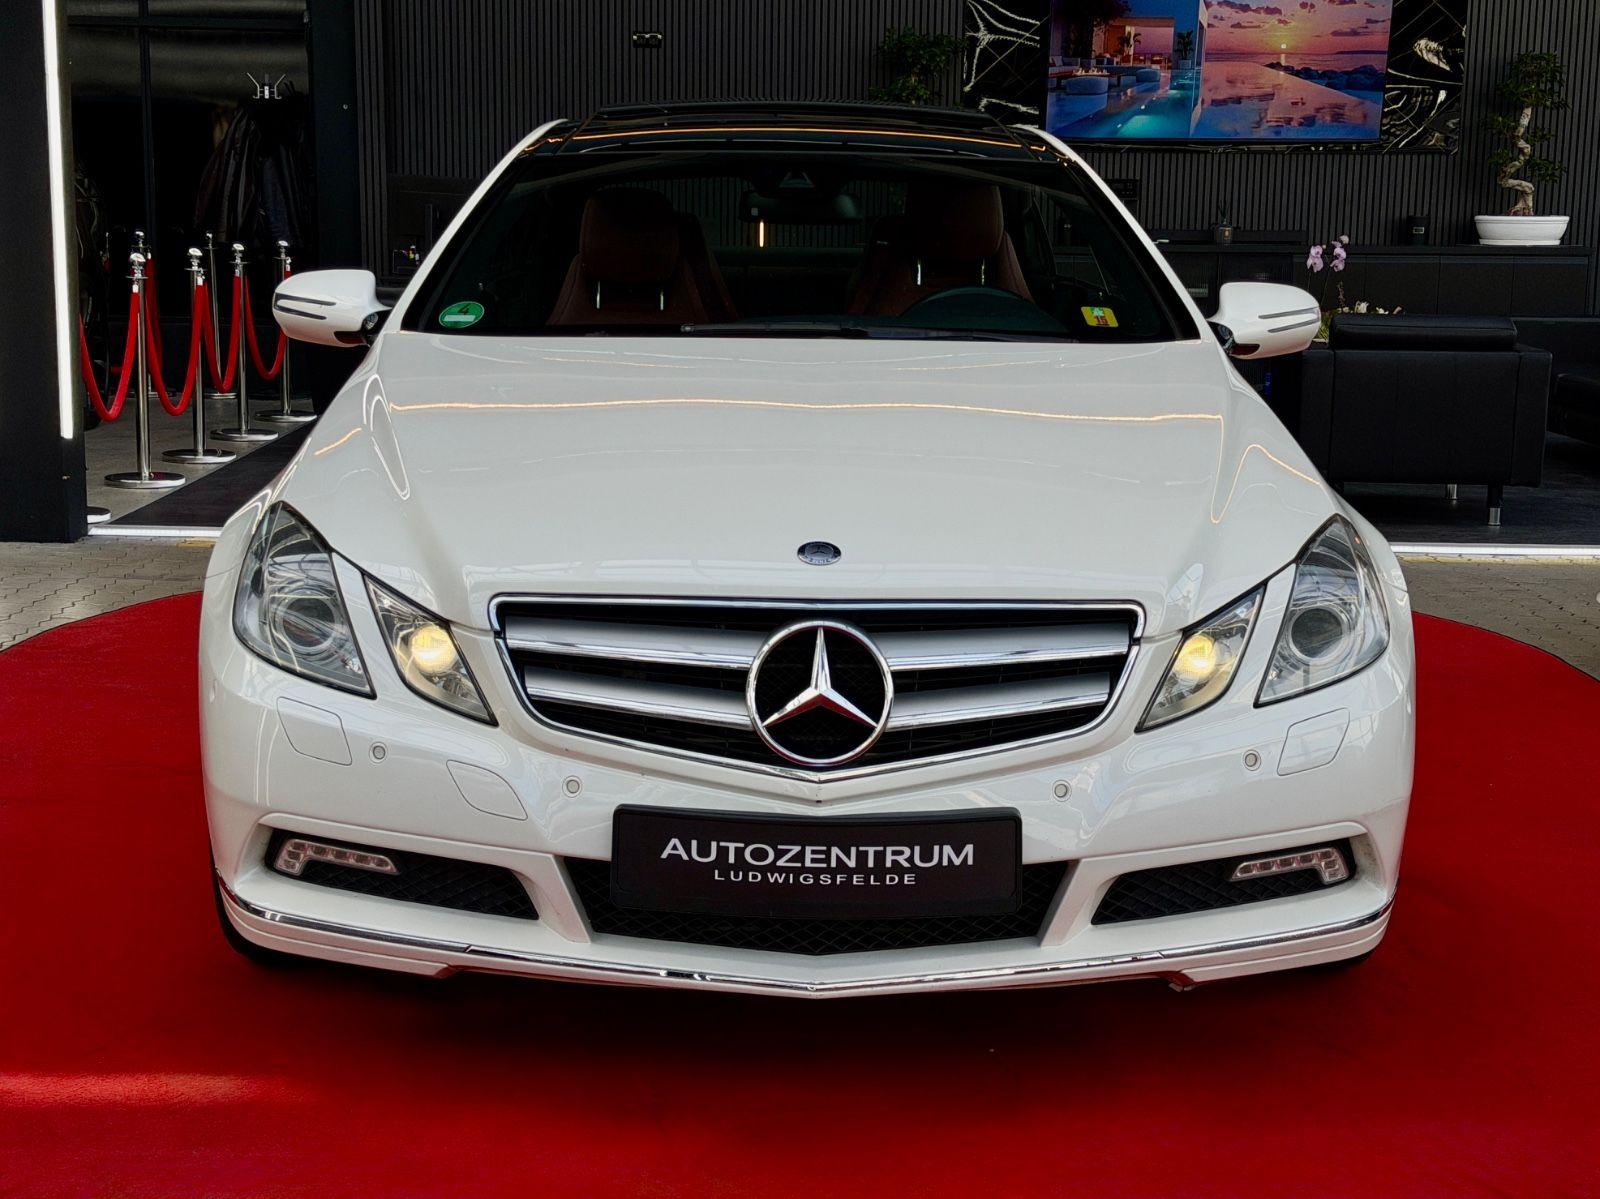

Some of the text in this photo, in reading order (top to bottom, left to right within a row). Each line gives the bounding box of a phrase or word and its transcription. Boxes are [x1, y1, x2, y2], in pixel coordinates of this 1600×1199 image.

[457, 303, 471, 315] 4
[660, 837, 974, 868] AUTOZENTRUM
[714, 869, 917, 886] LUDWIGSFELDE
